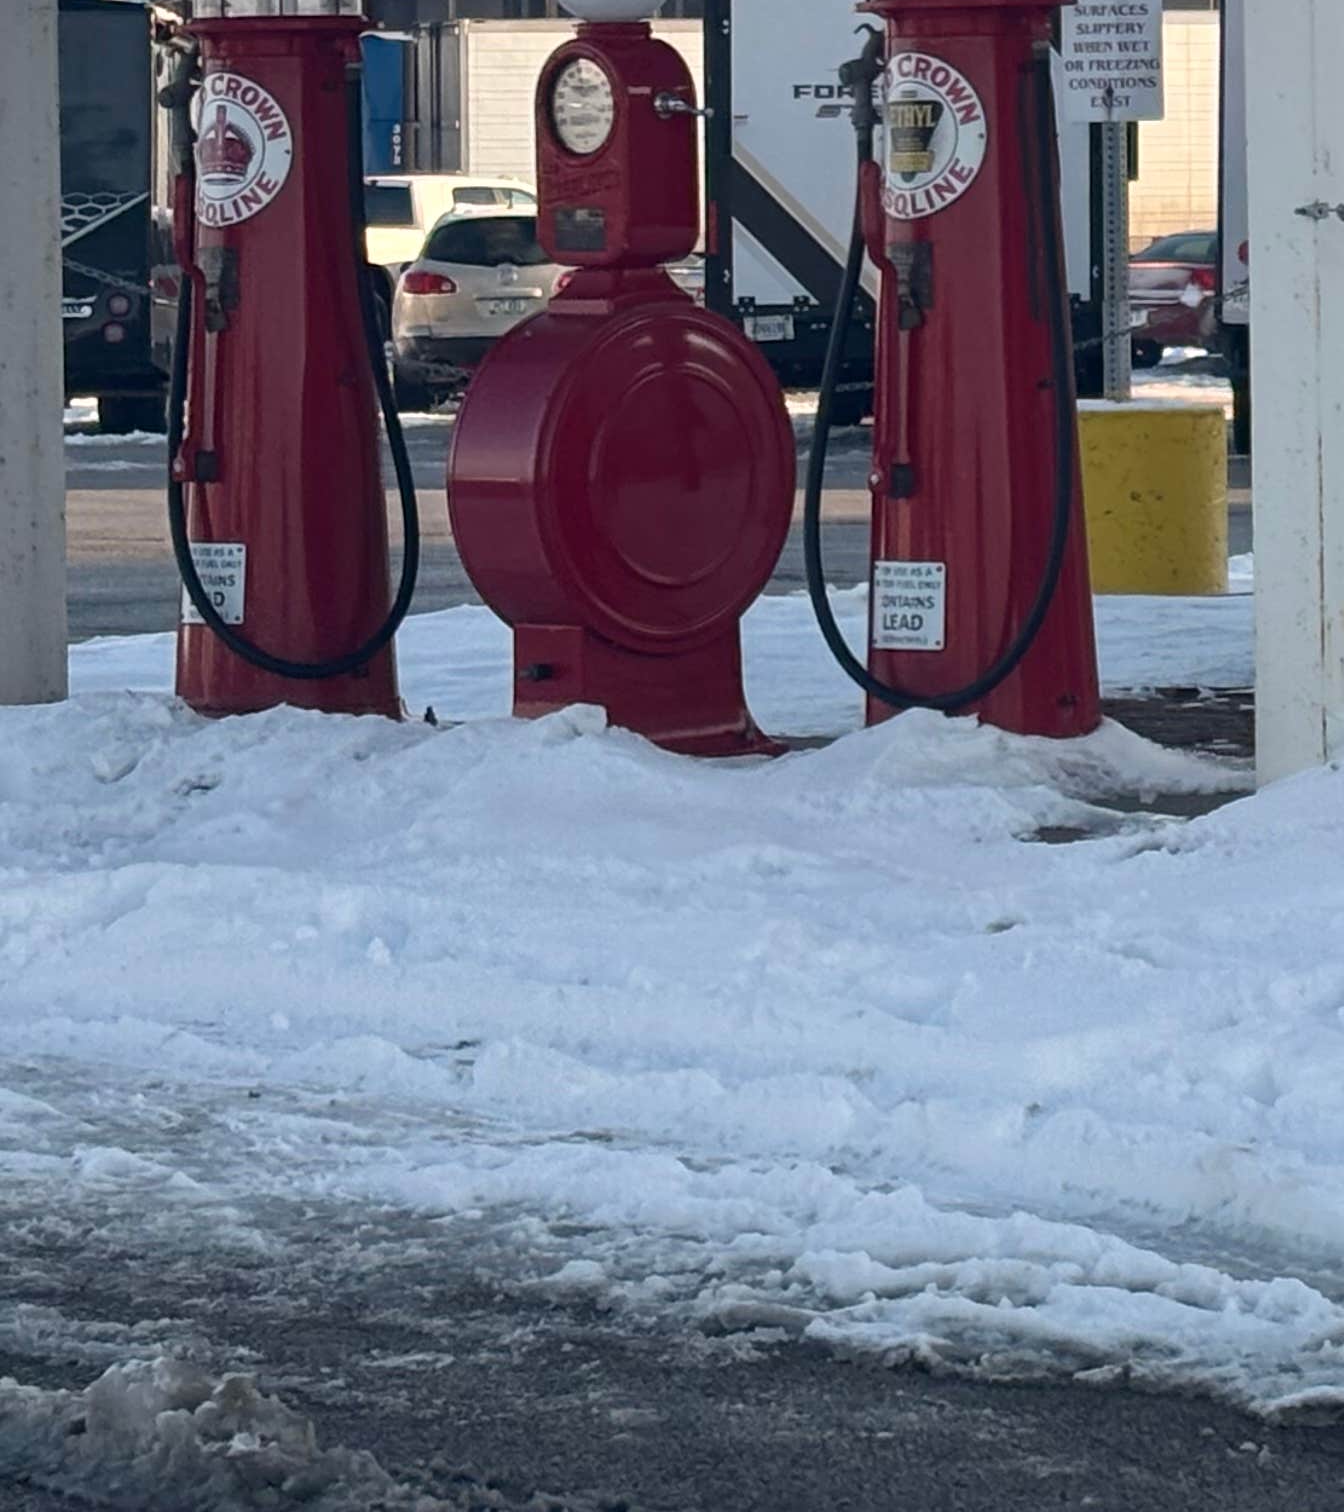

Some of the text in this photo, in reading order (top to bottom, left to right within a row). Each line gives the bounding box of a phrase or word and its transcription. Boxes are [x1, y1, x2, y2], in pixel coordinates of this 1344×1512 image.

[1074, 3, 1149, 18] SURFACES
[1076, 22, 1146, 36] SLIPPERY
[1073, 40, 1151, 54] WHEN WET
[1064, 58, 1160, 73] OR FREEZING
[898, 55, 981, 126] CROWN
[1069, 76, 1158, 90] CONDITIONS
[211, 74, 288, 141] CROWN
[881, 594, 935, 609] ONTAINS
[882, 613, 924, 631] LEAD
